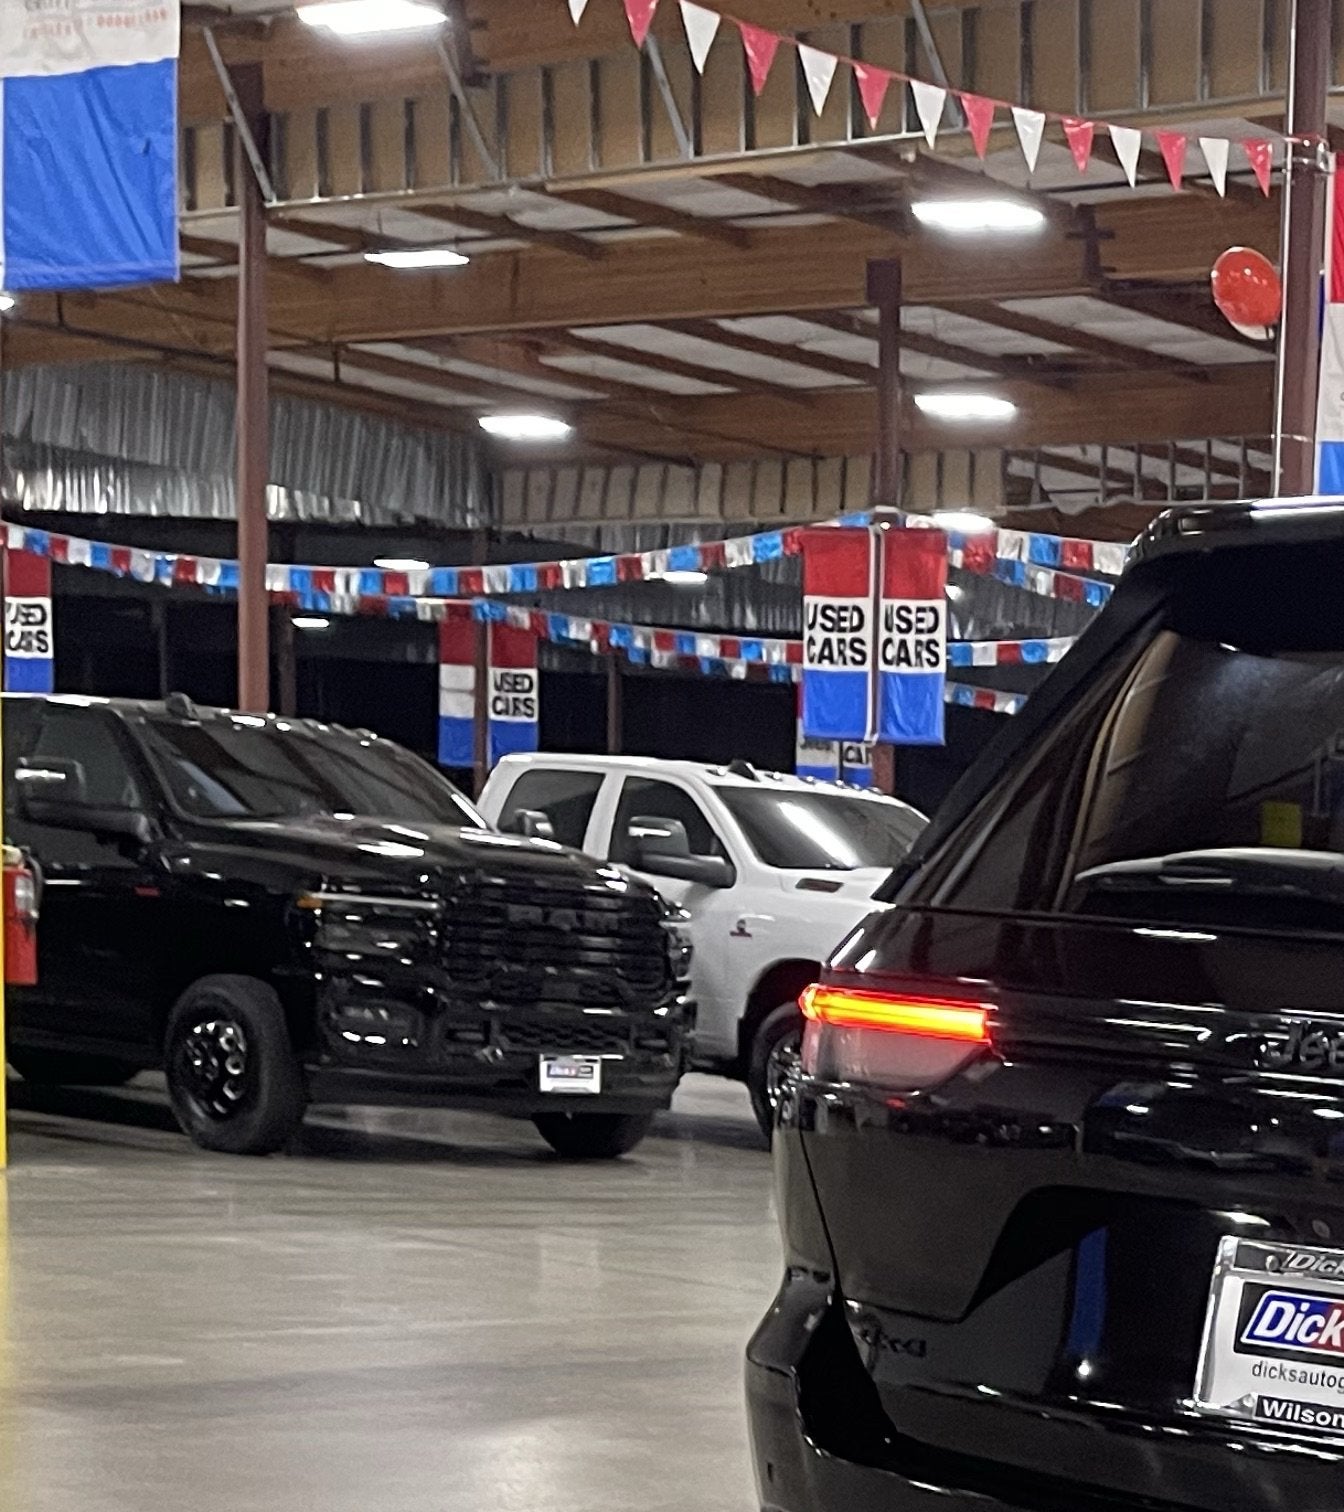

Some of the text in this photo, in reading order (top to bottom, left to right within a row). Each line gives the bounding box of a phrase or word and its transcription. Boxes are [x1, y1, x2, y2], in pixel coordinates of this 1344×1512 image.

[806, 603, 865, 633] USED
[884, 605, 940, 634] USED
[805, 637, 868, 667] CARS
[881, 638, 941, 668] CARS
